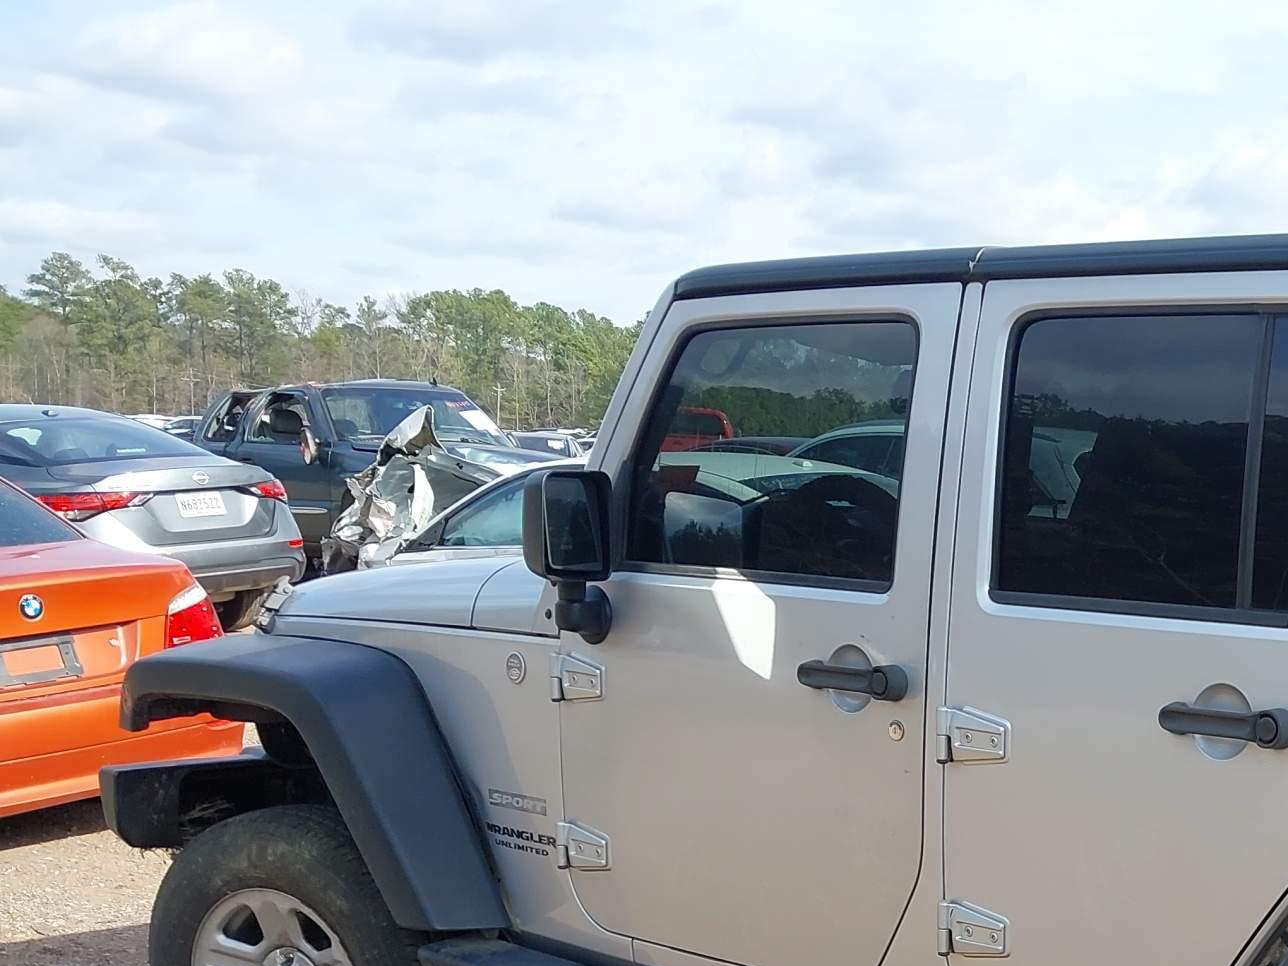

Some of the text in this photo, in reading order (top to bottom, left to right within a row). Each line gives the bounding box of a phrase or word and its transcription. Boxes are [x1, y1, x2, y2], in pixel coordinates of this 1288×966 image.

[488, 792, 546, 812] SPORT
[486, 821, 557, 848] WRANGLER
[495, 838, 549, 856] UNLIMITED
